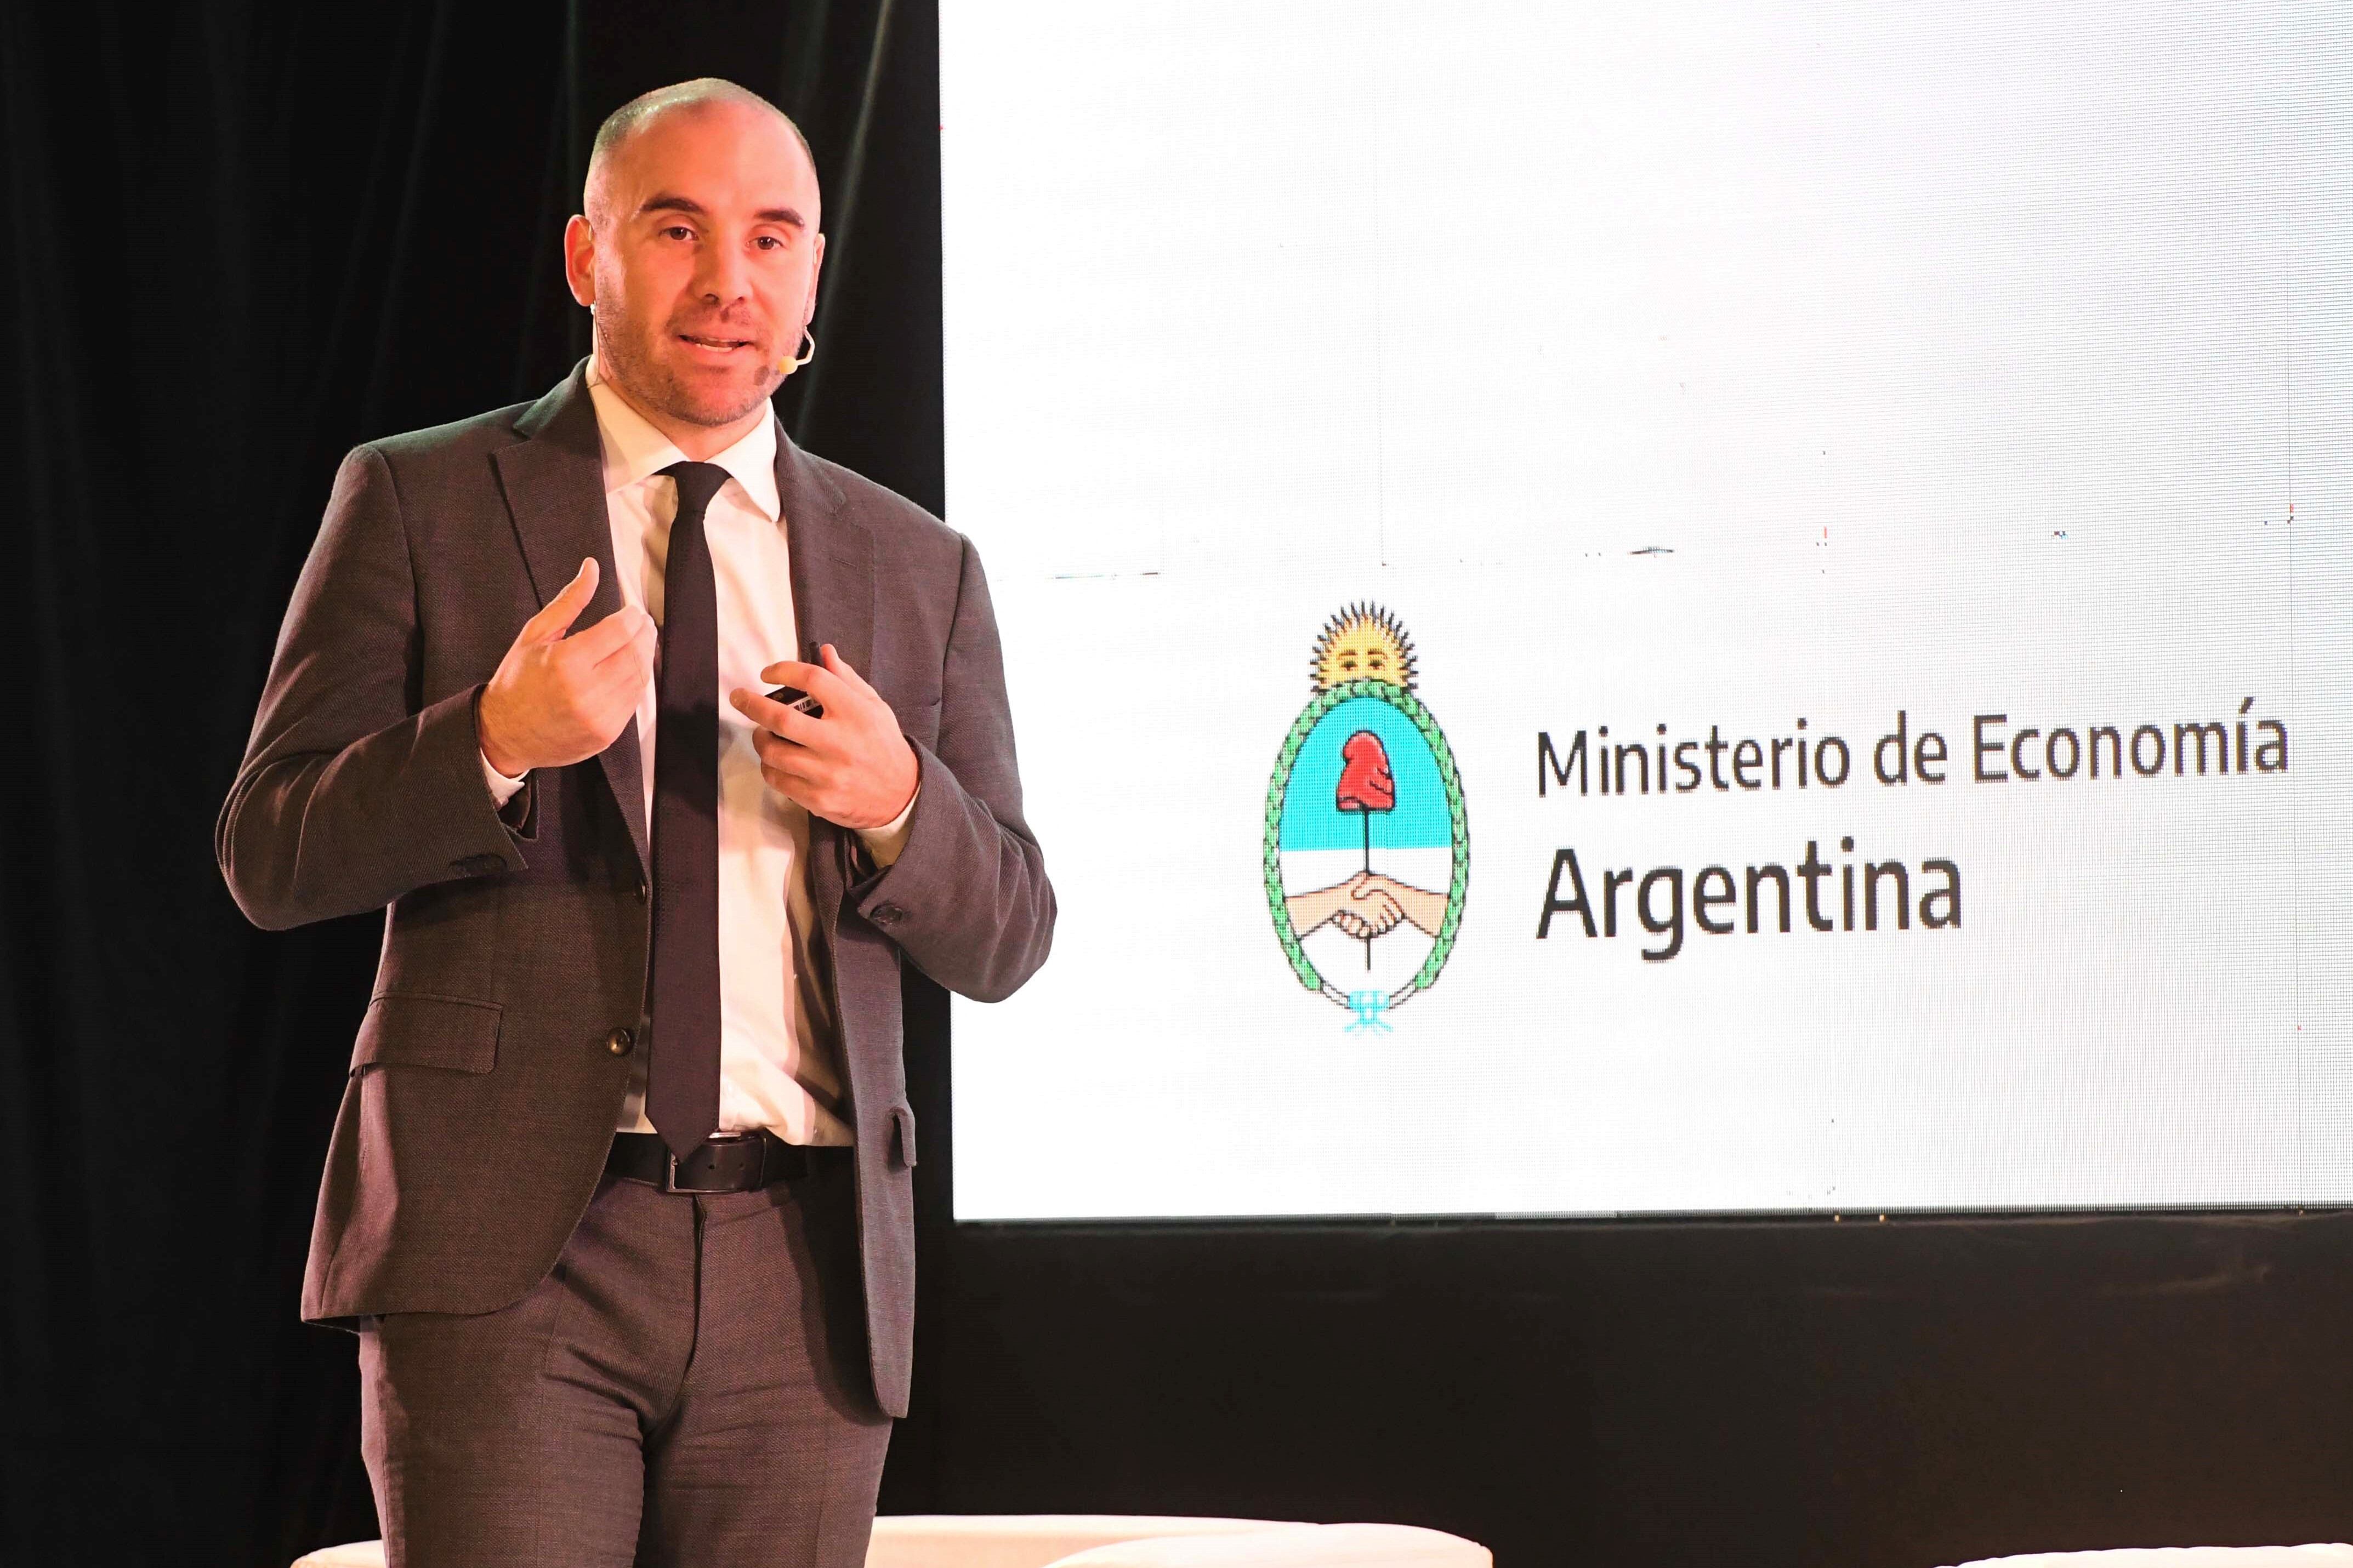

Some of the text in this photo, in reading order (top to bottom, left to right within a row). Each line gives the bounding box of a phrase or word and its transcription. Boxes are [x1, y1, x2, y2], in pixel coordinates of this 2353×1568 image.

[1537, 697, 2288, 797] Ministerio de Economía
[1536, 836, 1962, 962] Argentina
